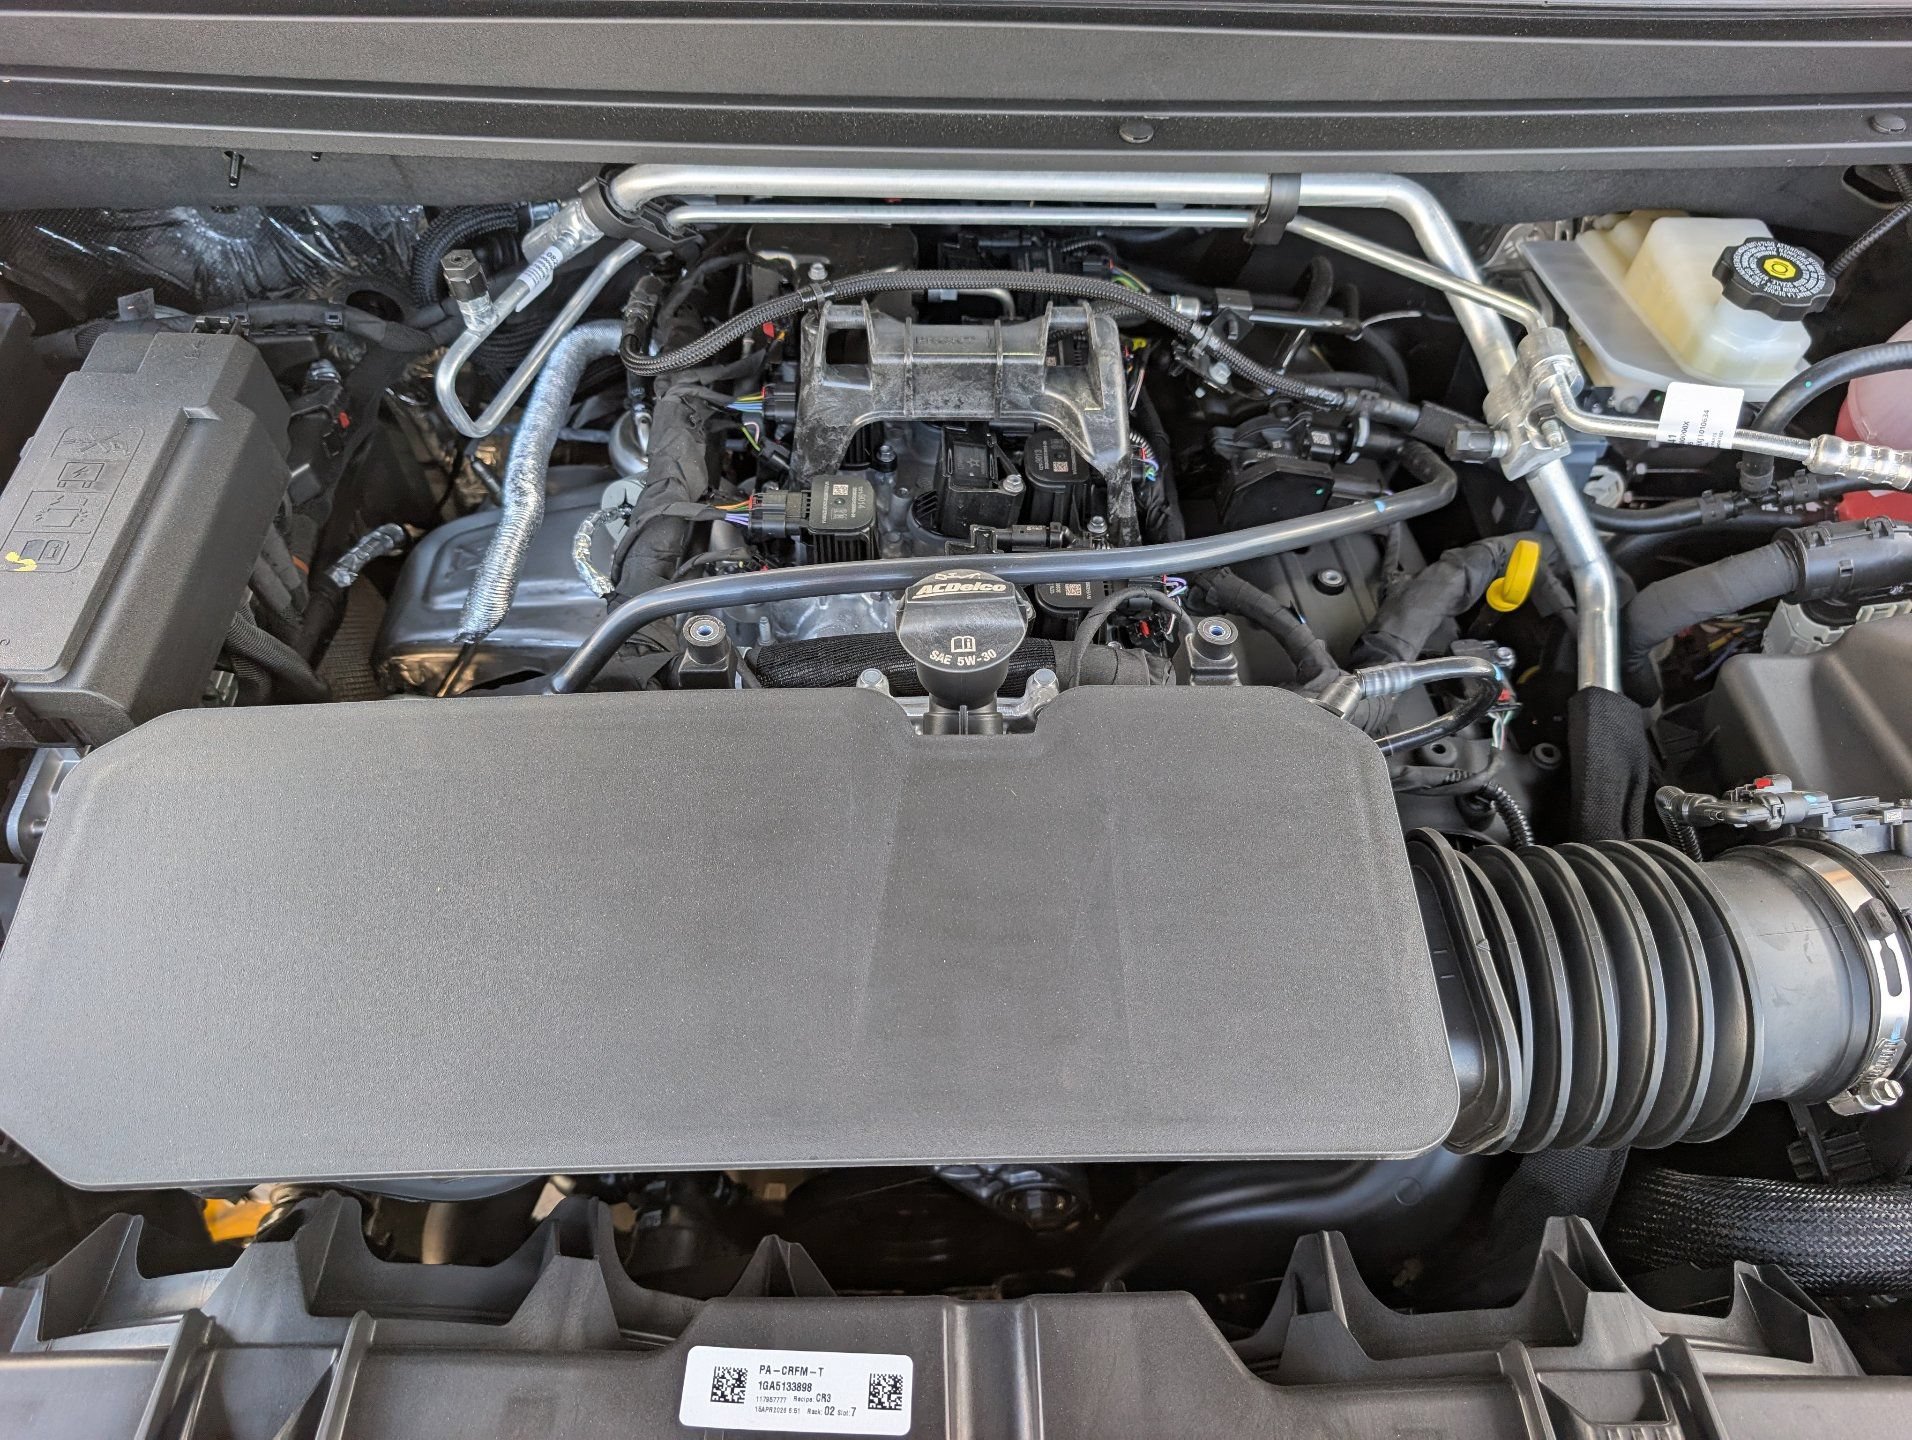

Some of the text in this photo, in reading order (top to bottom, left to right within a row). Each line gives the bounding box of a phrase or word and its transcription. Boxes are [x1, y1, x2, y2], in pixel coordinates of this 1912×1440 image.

[912, 582, 1007, 598] ACDelco
[929, 649, 997, 666] SAE 5W-30
[758, 1380, 812, 1392] 1GA5133898
[816, 1393, 832, 1403] CR3
[824, 1406, 836, 1416] 02
[851, 1406, 857, 1417] 7
